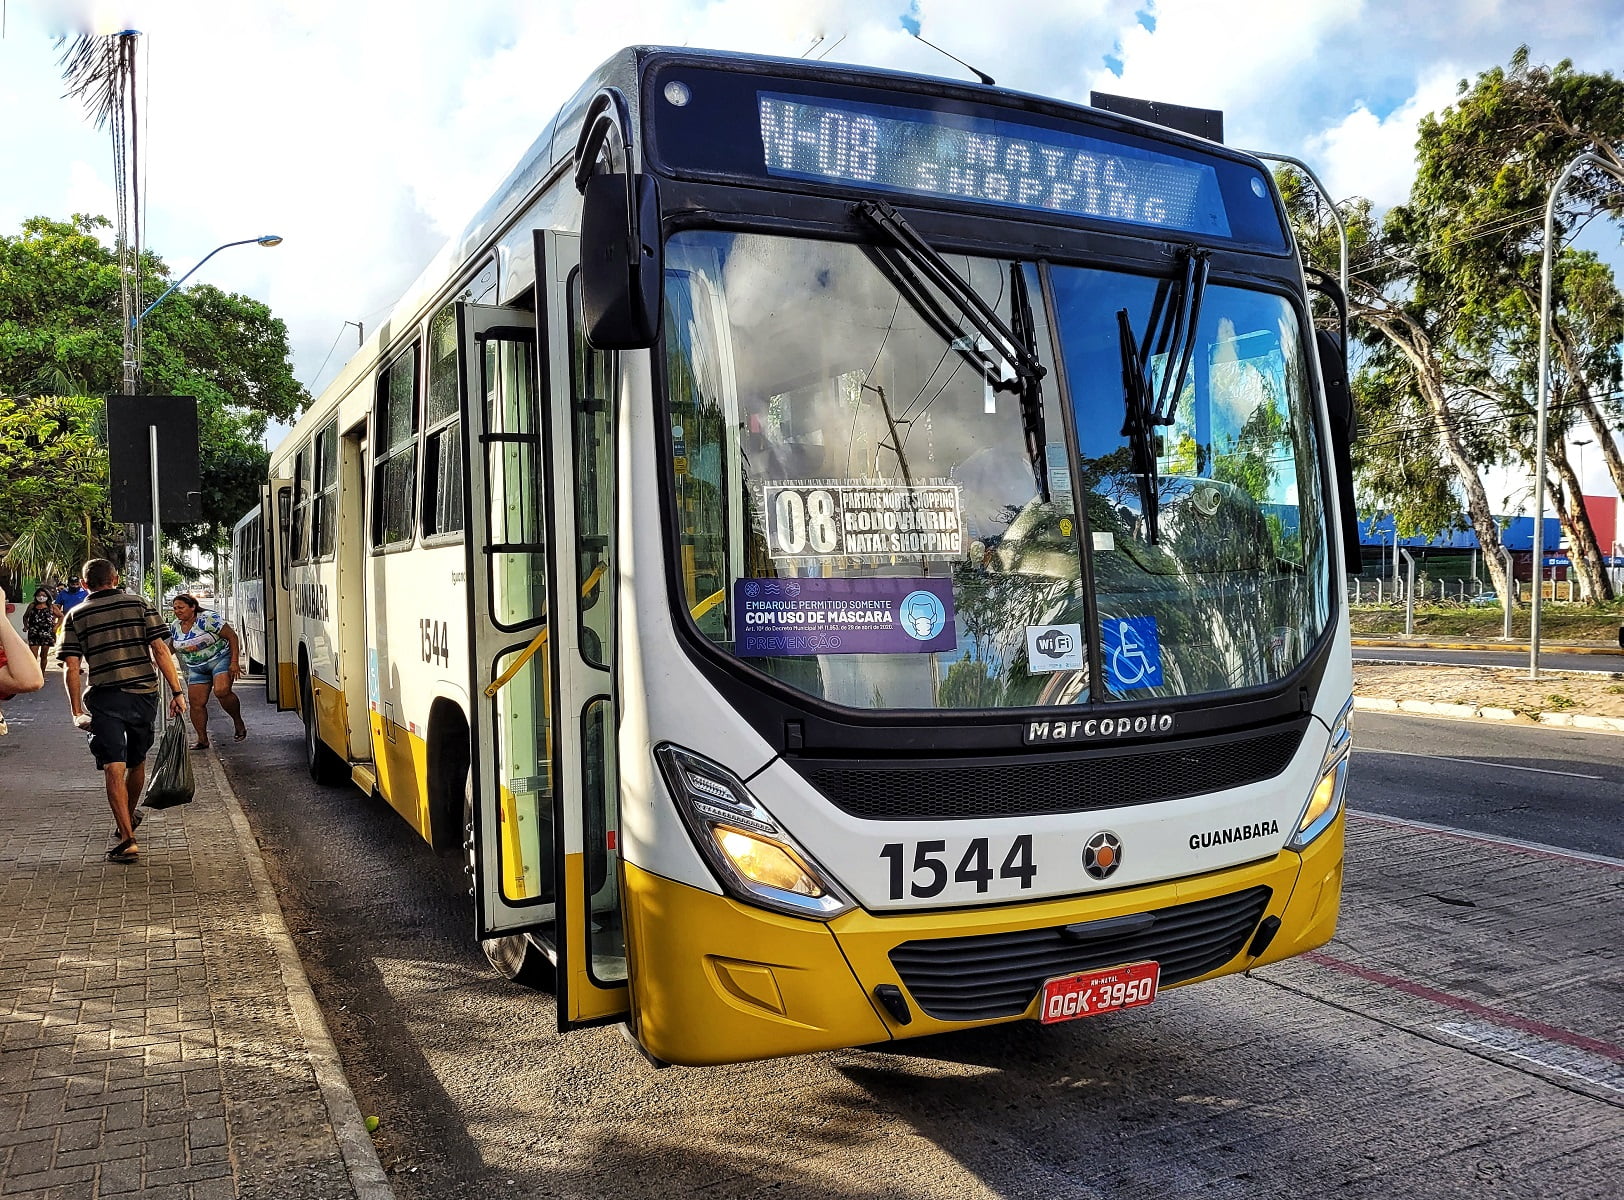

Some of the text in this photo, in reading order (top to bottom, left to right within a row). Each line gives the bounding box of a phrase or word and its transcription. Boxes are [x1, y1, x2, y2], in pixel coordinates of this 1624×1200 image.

[761, 101, 877, 179] N-08
[967, 136, 1127, 188] NATAL
[917, 162, 1166, 223] SHOPPING
[843, 493, 881, 509] PARTAGE
[912, 492, 954, 508] SHOPPING
[776, 490, 837, 553] 08
[846, 532, 959, 552] NATAL SHOPPING
[745, 606, 893, 624] COM USO DE MÁSCARA
[746, 600, 892, 610] EMBARQUE PERMITIDO SOMENTE
[419, 618, 449, 669] 1544
[746, 632, 842, 651] PREVENÇÃO
[1029, 714, 1174, 741] Marcopolo
[1188, 819, 1280, 850] GUANABARA
[878, 833, 1038, 901] 1544
